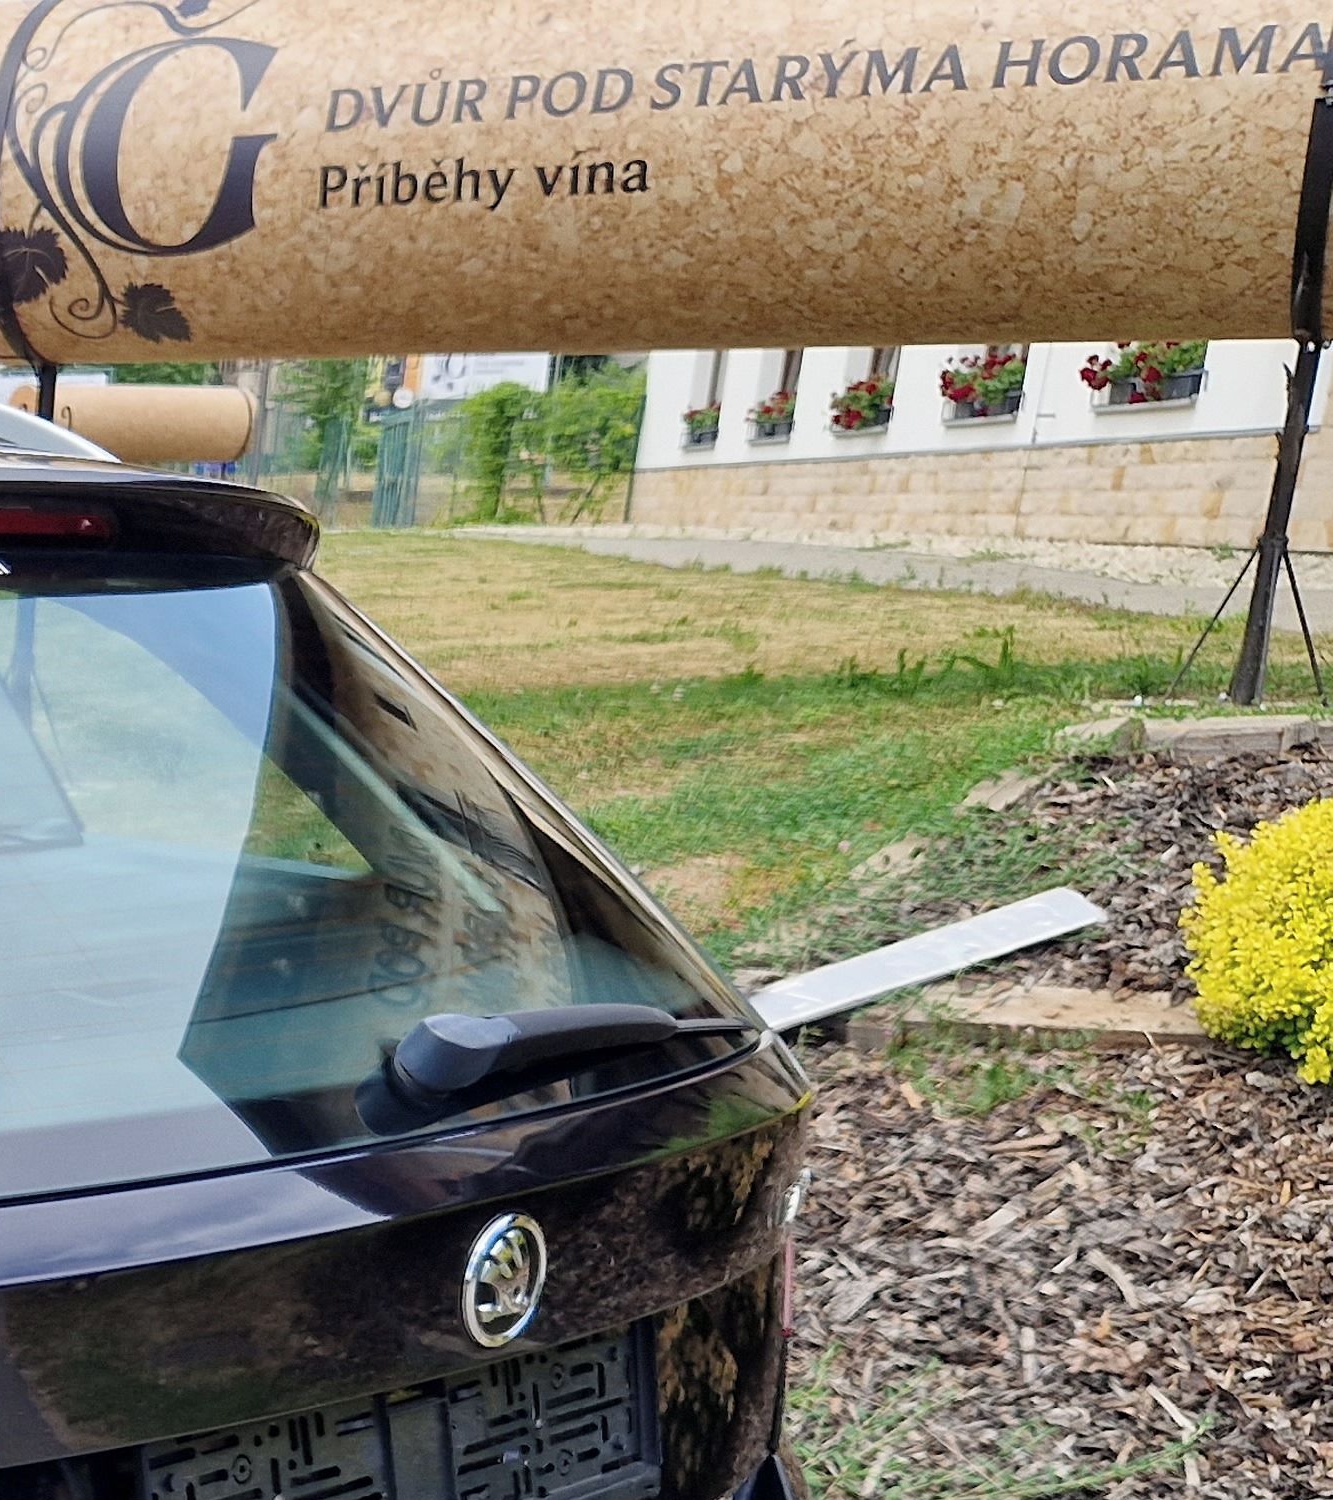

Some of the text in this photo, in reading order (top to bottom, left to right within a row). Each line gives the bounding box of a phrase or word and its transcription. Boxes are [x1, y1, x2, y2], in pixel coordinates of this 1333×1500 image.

[324, 22, 1325, 133] DVŮR POD STARÝMA HORAMA
[319, 150, 651, 211] Příběhy vína
